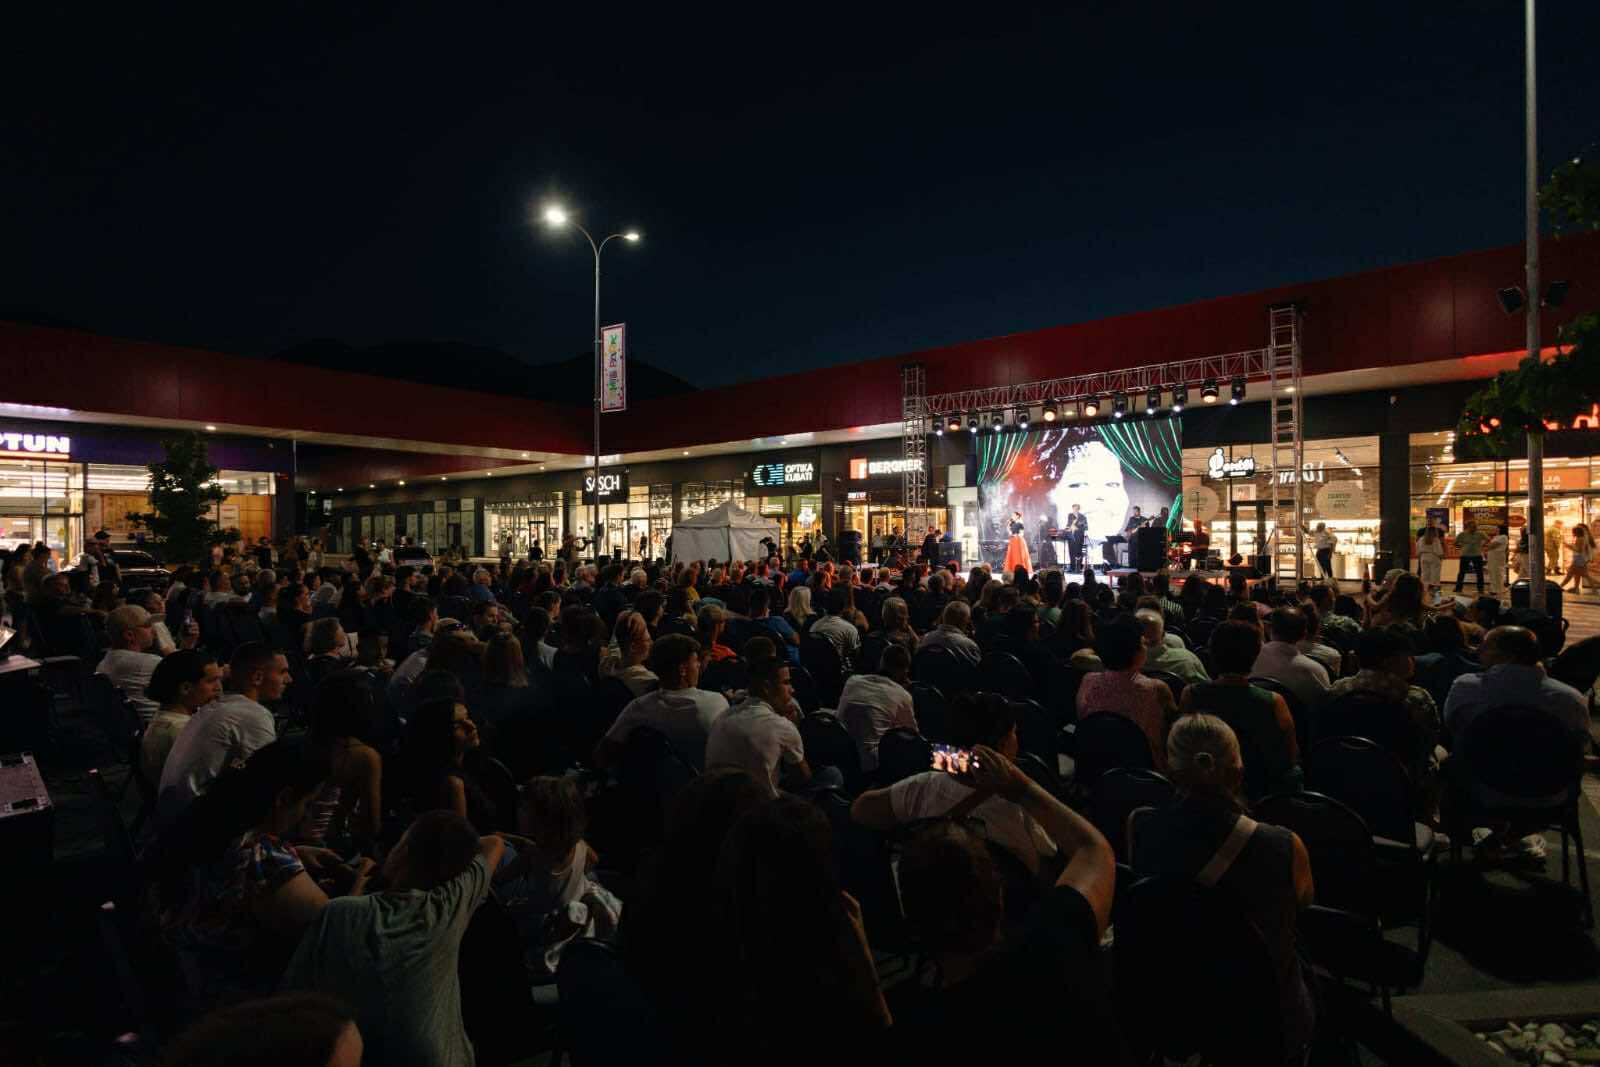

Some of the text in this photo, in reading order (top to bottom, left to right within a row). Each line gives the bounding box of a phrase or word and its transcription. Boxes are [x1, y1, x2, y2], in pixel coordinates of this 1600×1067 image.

[0, 432, 70, 453] TUN
[785, 463, 813, 473] OPTIKA
[869, 459, 922, 474] BERGNER
[785, 472, 812, 481] KUBATI
